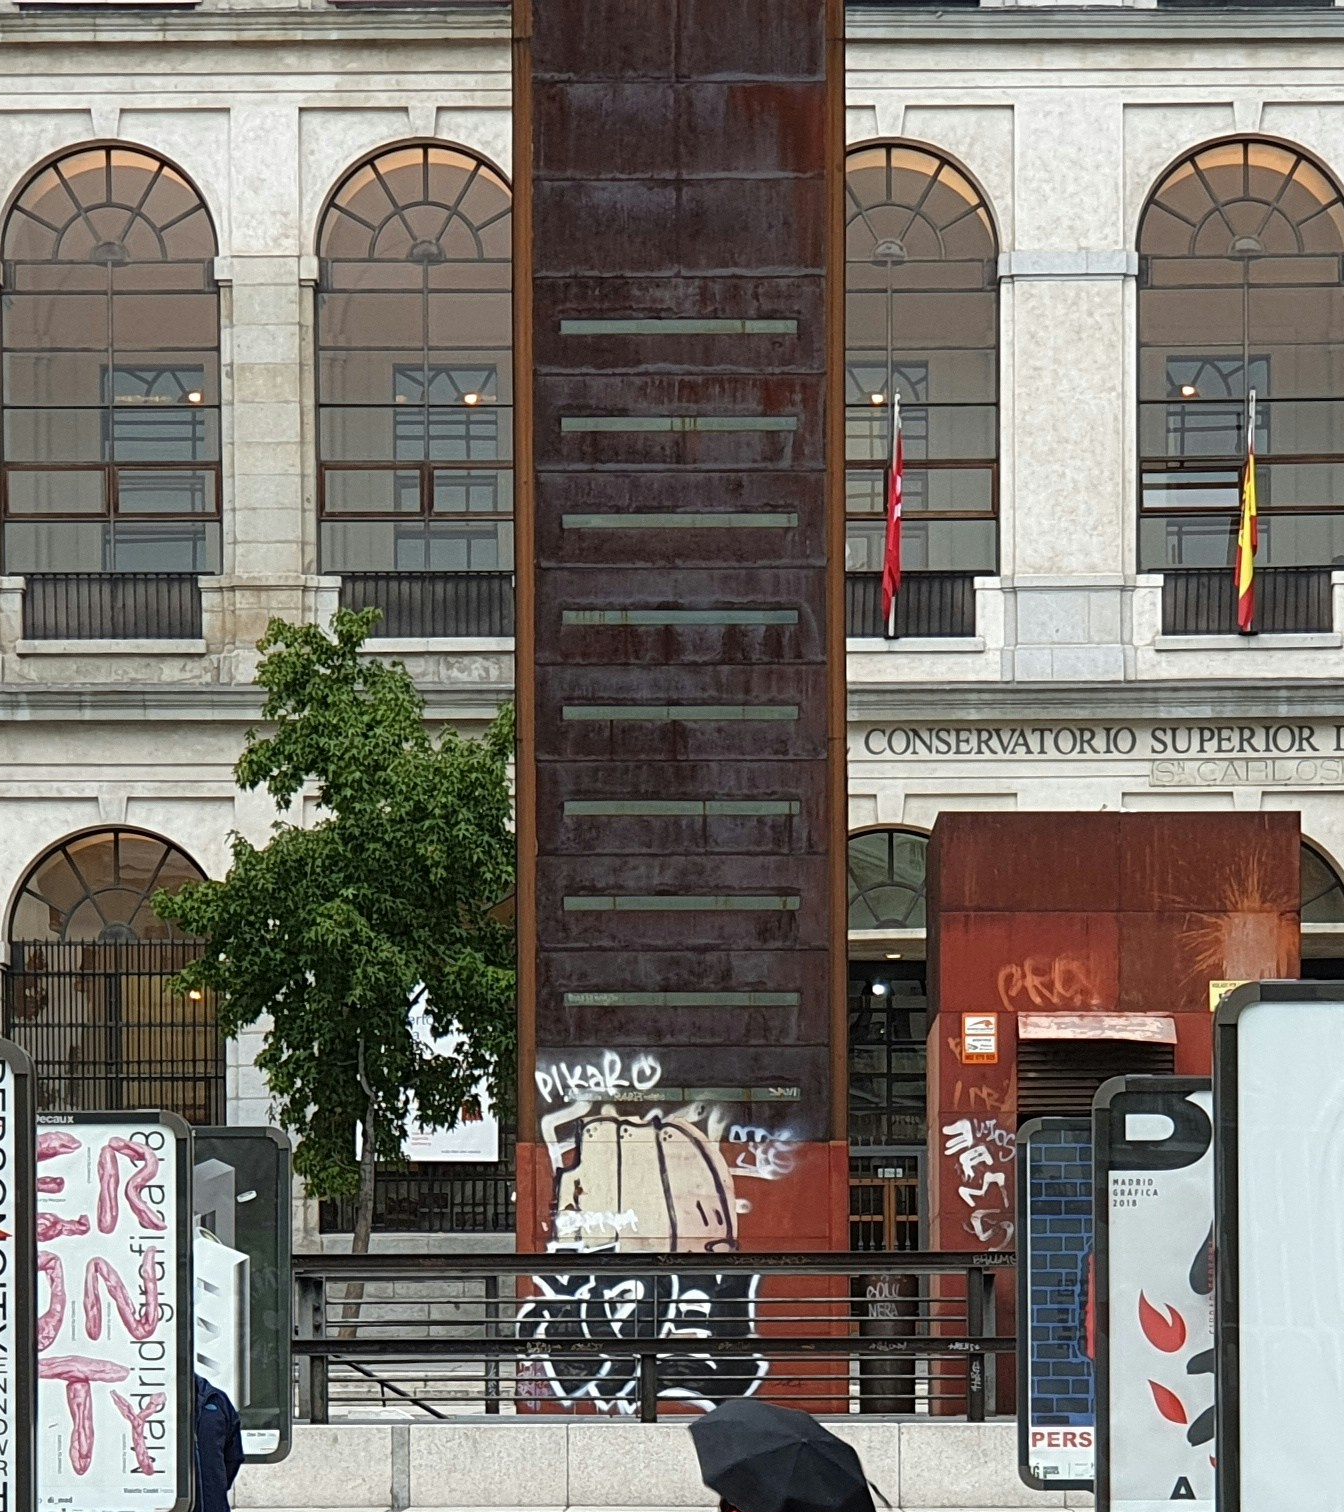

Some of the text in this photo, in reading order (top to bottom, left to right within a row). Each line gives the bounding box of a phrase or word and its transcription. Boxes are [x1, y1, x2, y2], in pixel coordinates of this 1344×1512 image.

[864, 727, 1138, 755] CONSERVATORIO
[1150, 724, 1320, 754] SUPERIOR
[1113, 1178, 1154, 1187] MADRID
[1113, 1199, 1138, 1207] 2018
[1031, 1431, 1093, 1448] PERS
